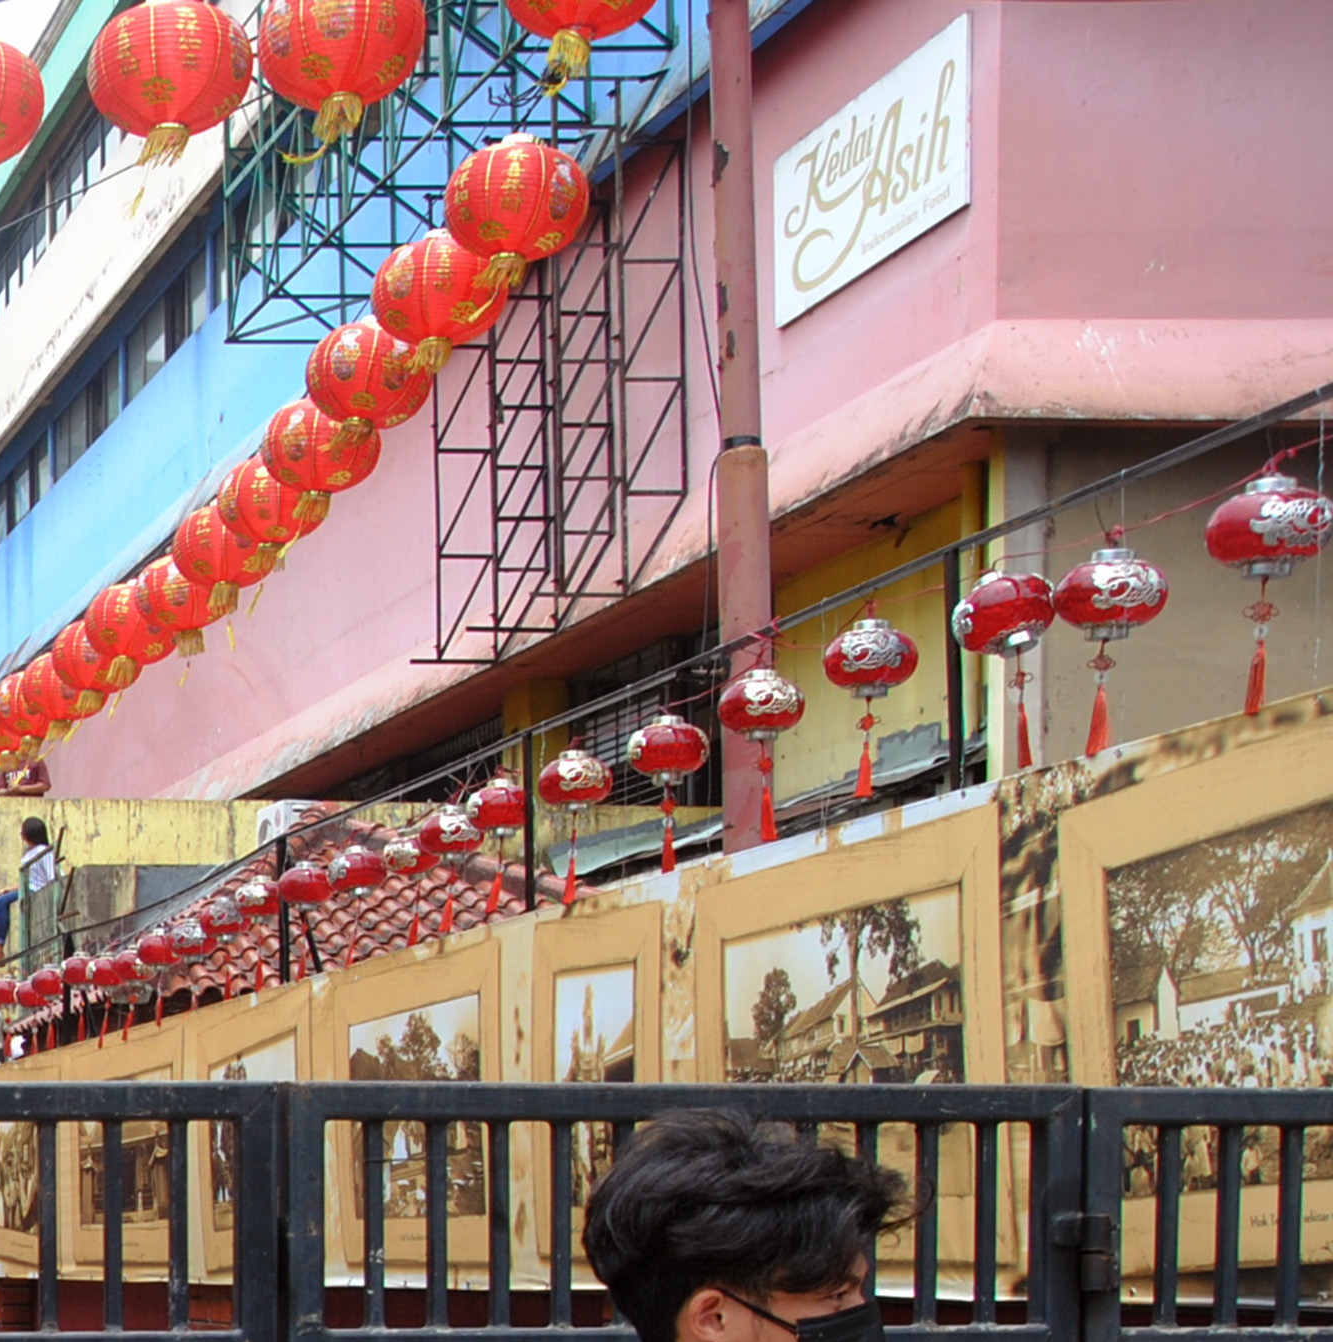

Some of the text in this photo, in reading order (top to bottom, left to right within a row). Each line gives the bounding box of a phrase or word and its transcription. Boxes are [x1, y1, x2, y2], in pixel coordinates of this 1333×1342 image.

[785, 115, 874, 238] Kedai
[793, 59, 954, 292] Asih
[861, 184, 951, 254] Indonesian Food
